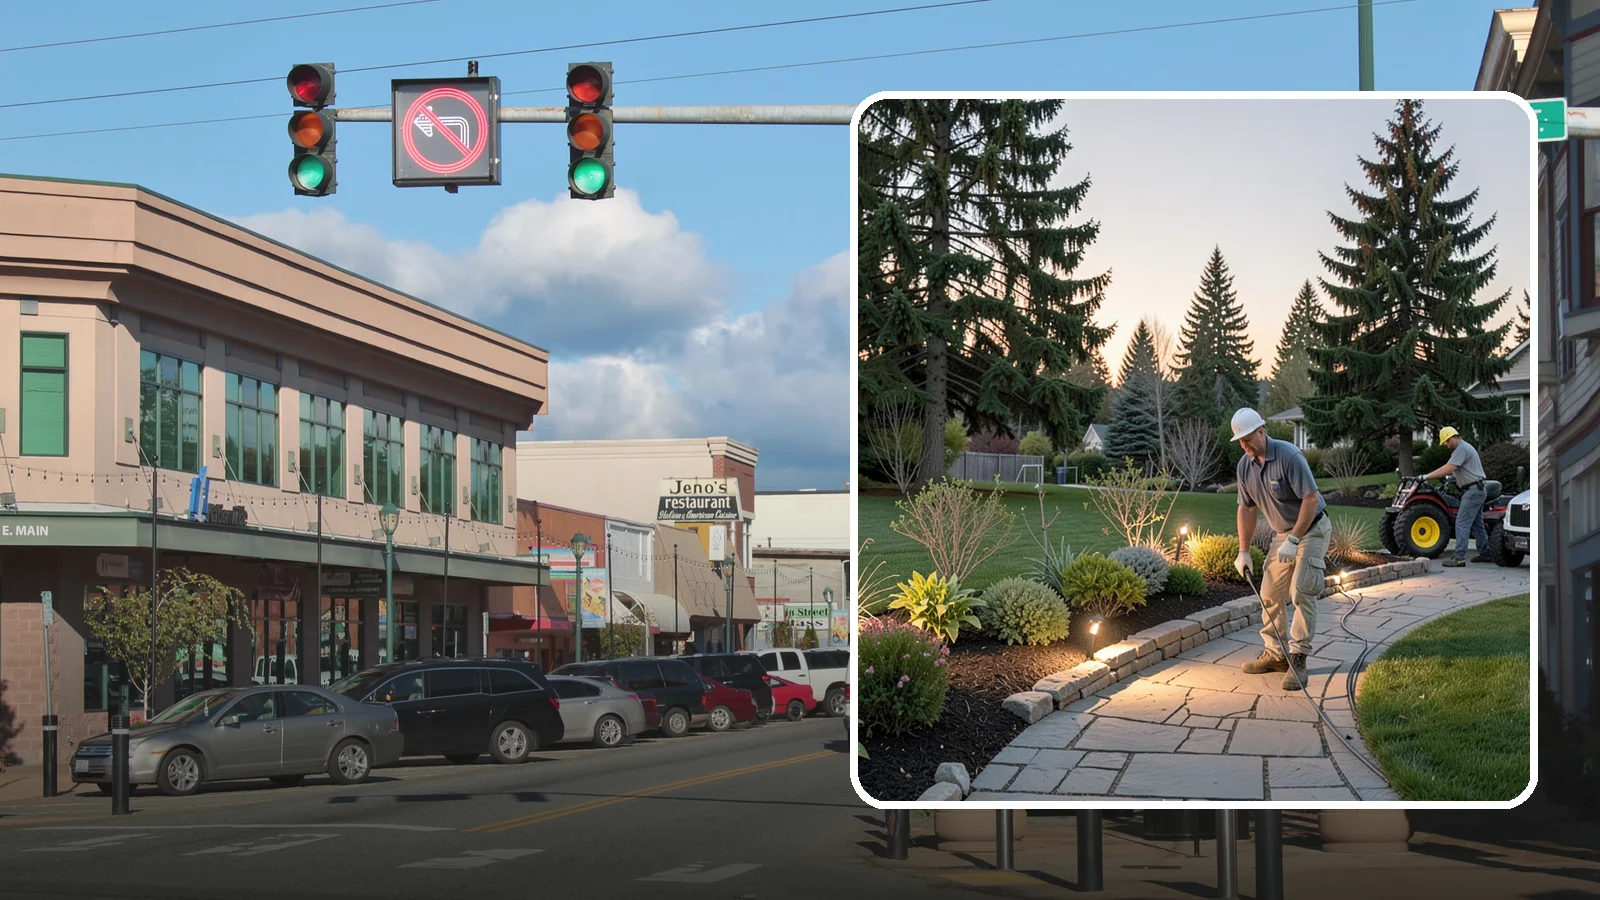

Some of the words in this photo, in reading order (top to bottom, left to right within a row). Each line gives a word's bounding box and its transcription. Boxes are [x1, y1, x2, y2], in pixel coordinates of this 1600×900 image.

[669, 480, 727, 494] Jeno's
[665, 496, 731, 509] restaurant
[658, 510, 682, 520] Italian
[686, 509, 714, 519] American
[714, 509, 738, 520] Cuisine
[2, 525, 13, 536] E.
[15, 525, 49, 536] MAIN
[797, 607, 828, 616] Street
